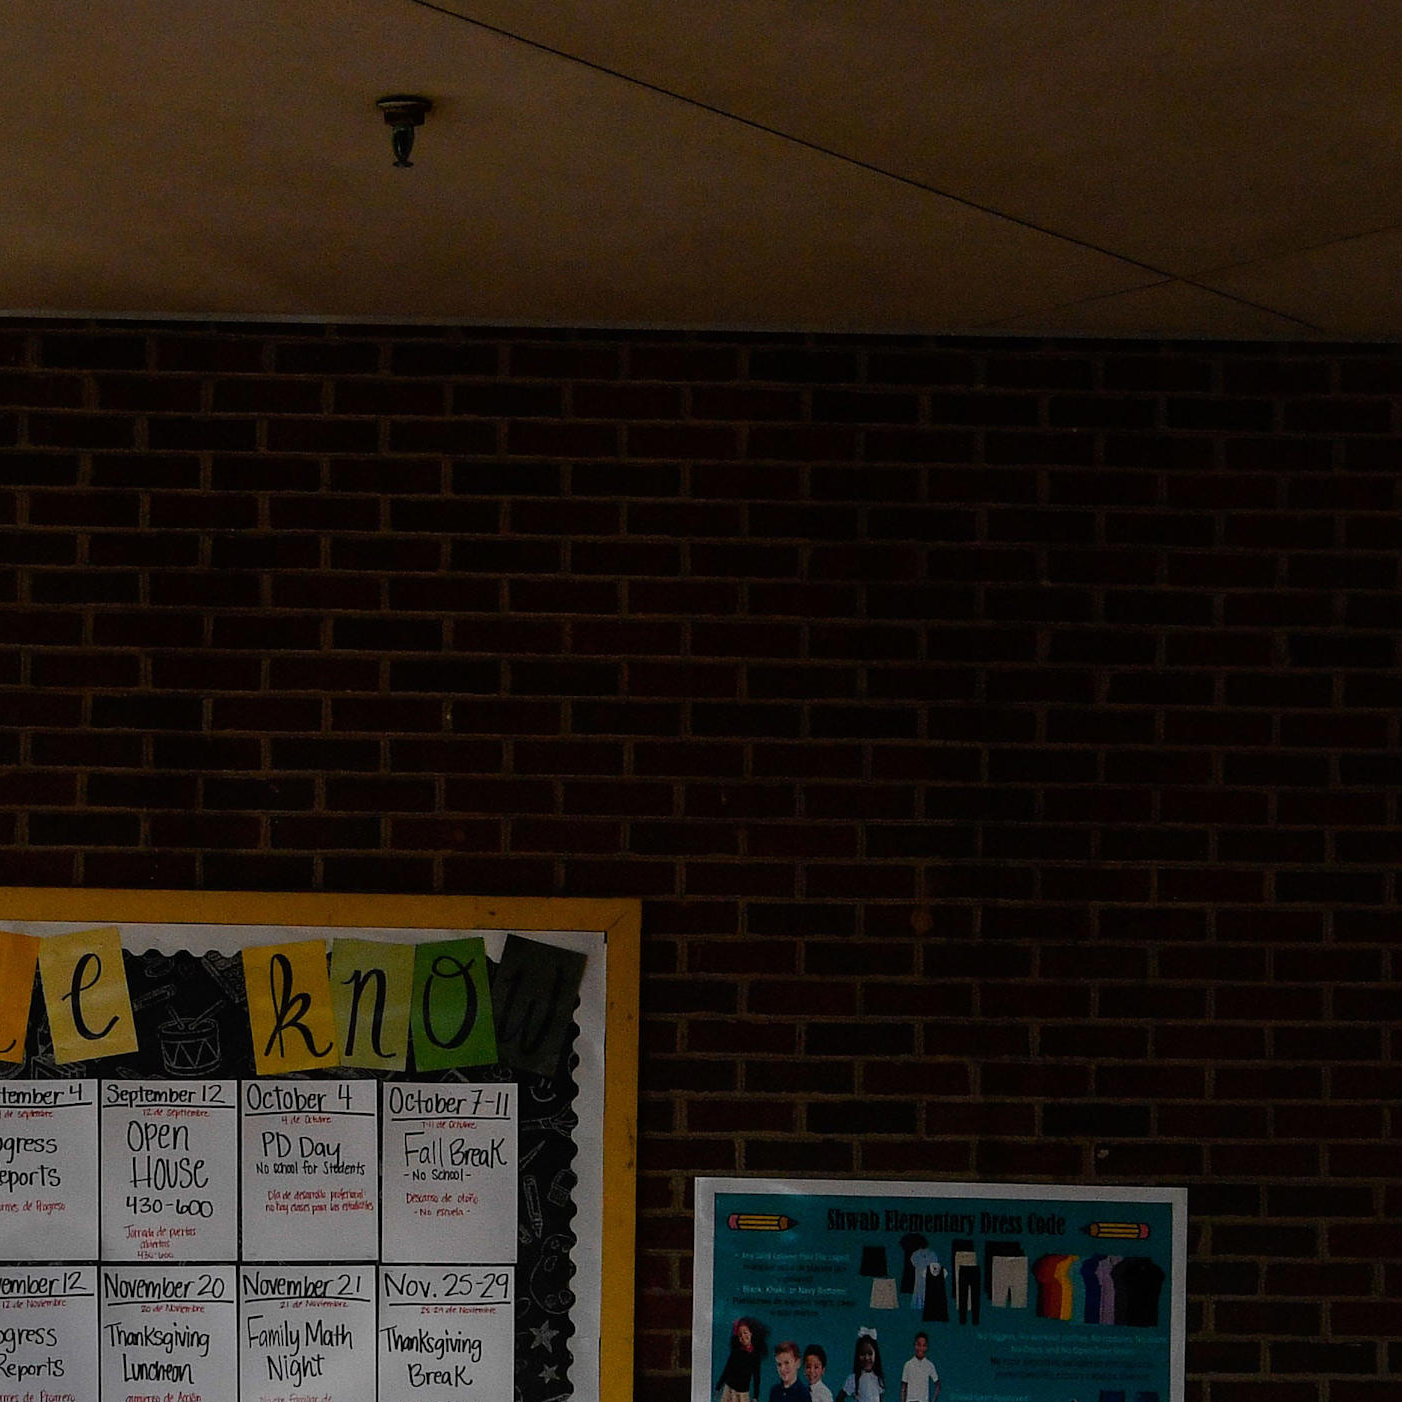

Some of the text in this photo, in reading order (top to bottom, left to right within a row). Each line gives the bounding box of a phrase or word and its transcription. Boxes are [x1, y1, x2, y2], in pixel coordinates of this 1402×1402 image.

[69, 1083, 82, 1100] 4
[106, 1084, 226, 1108] September 12
[247, 1083, 352, 1113] October 4
[389, 1086, 509, 1117] October 7-11
[262, 1131, 341, 1166] PD Day
[404, 1131, 444, 1167] Fall
[827, 1208, 1066, 1236] Shwab Elementary Dress Code
[63, 1271, 87, 1294] 12
[104, 1272, 225, 1299] November 20
[242, 1271, 361, 1298] November 21
[384, 1273, 509, 1298] Nov. 25-29
[103, 1322, 210, 1358] Thanksgiving
[246, 1315, 353, 1357] Family Math
[379, 1325, 482, 1363] Thanksgiving
[122, 1353, 194, 1385] Luncheon
[266, 1354, 325, 1388] Night
